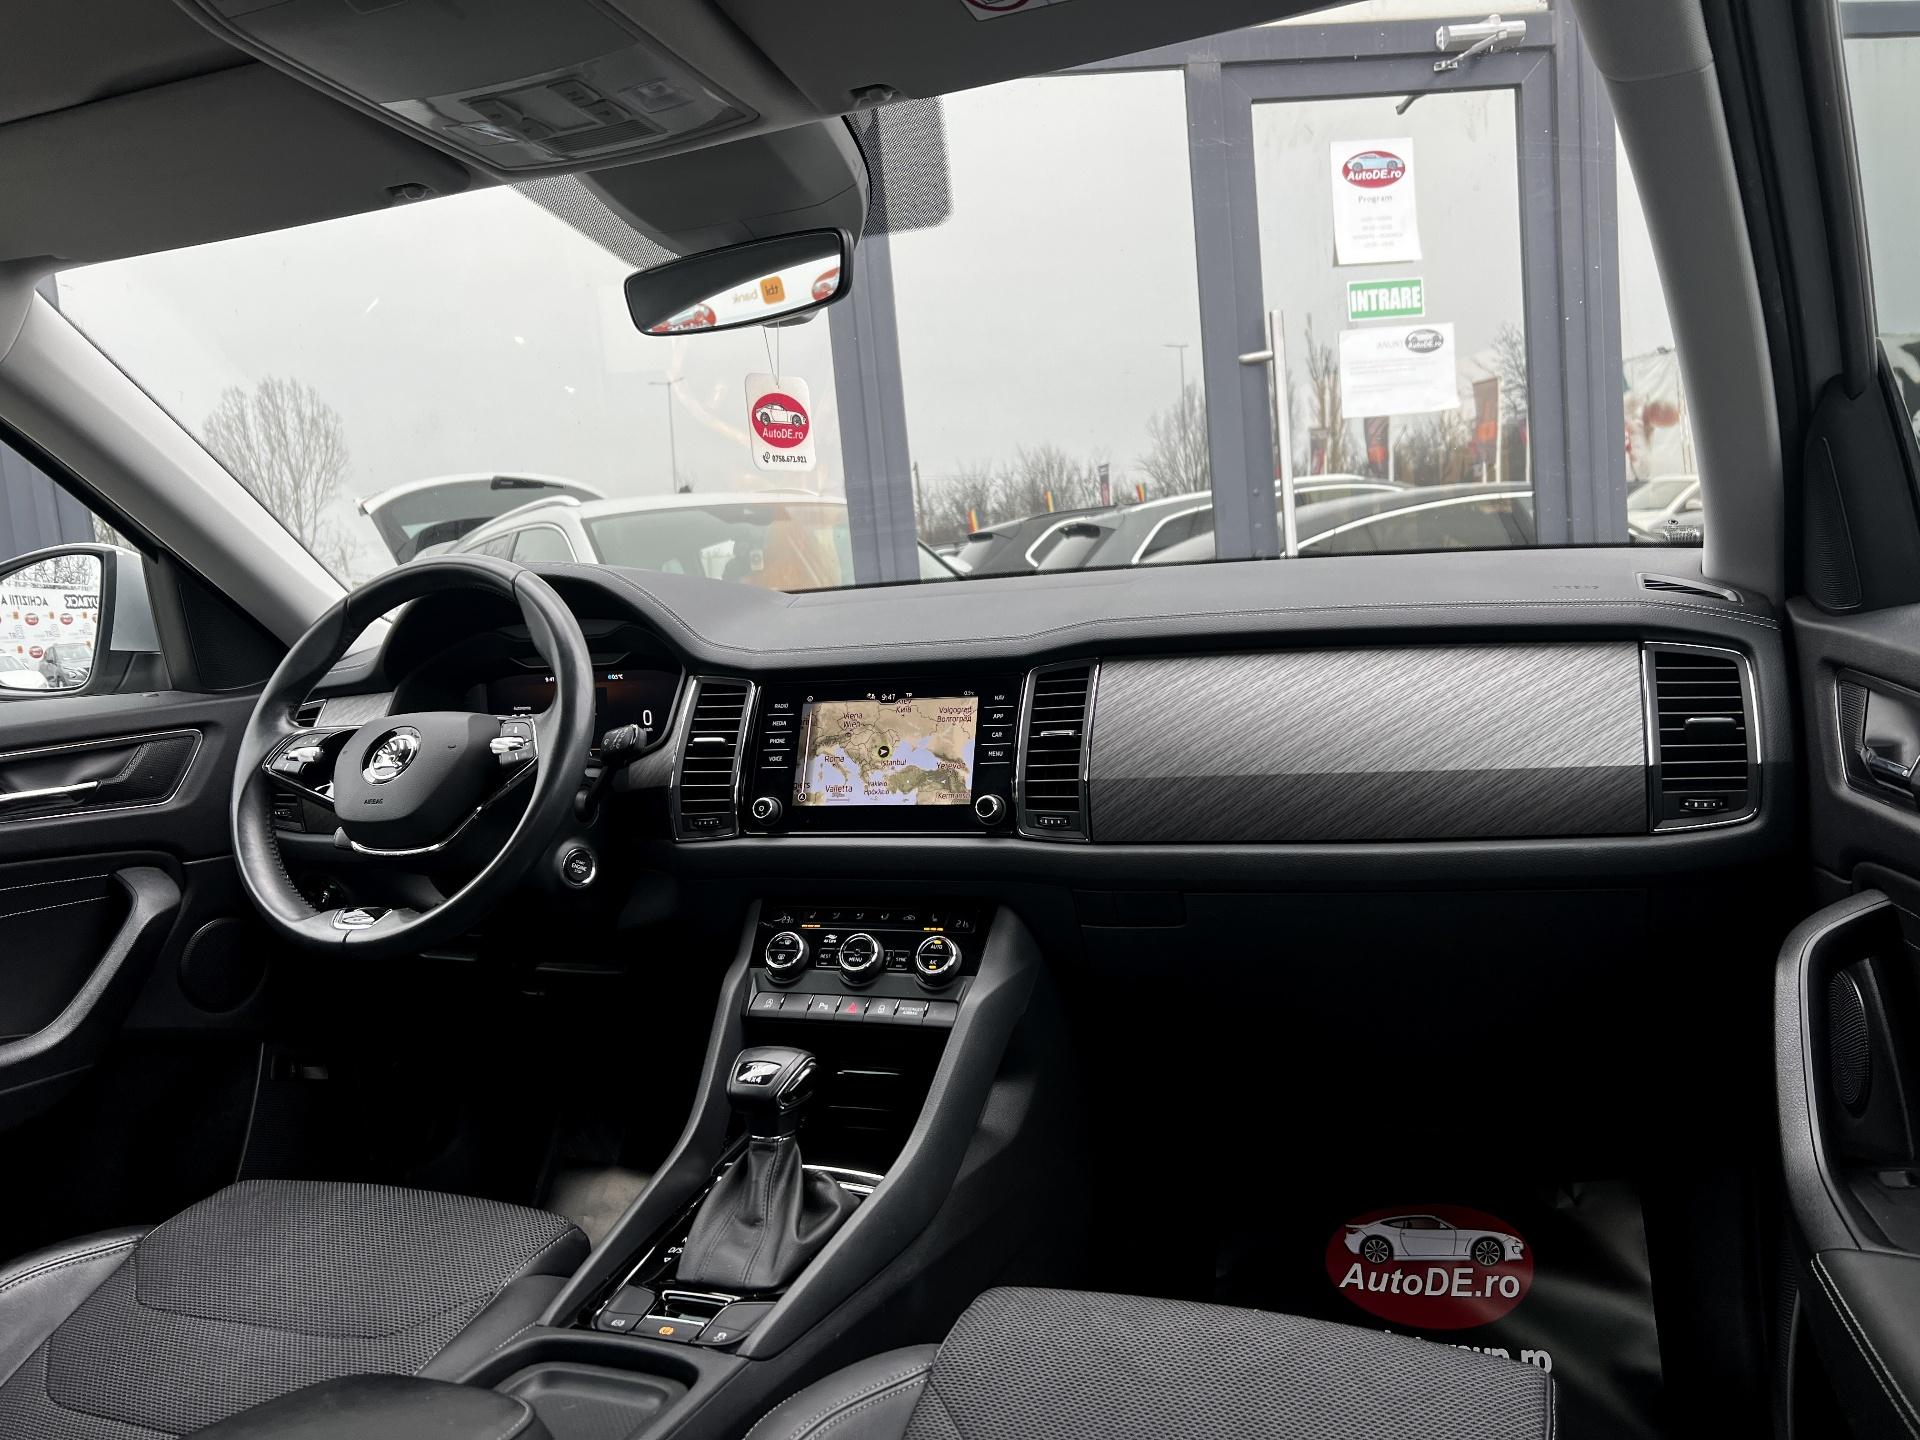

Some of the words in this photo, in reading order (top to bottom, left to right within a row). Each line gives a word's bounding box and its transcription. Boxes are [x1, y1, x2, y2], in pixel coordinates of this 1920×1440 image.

[1346, 168, 1403, 181] AutoDE.ro
[1358, 194, 1393, 204] Program
[1350, 285, 1422, 312] INTRARE
[762, 427, 804, 440] AutoDE.ro
[642, 709, 652, 725] 0
[825, 784, 853, 793] Valletta
[1339, 1262, 1520, 1299] AutoDE.ro
